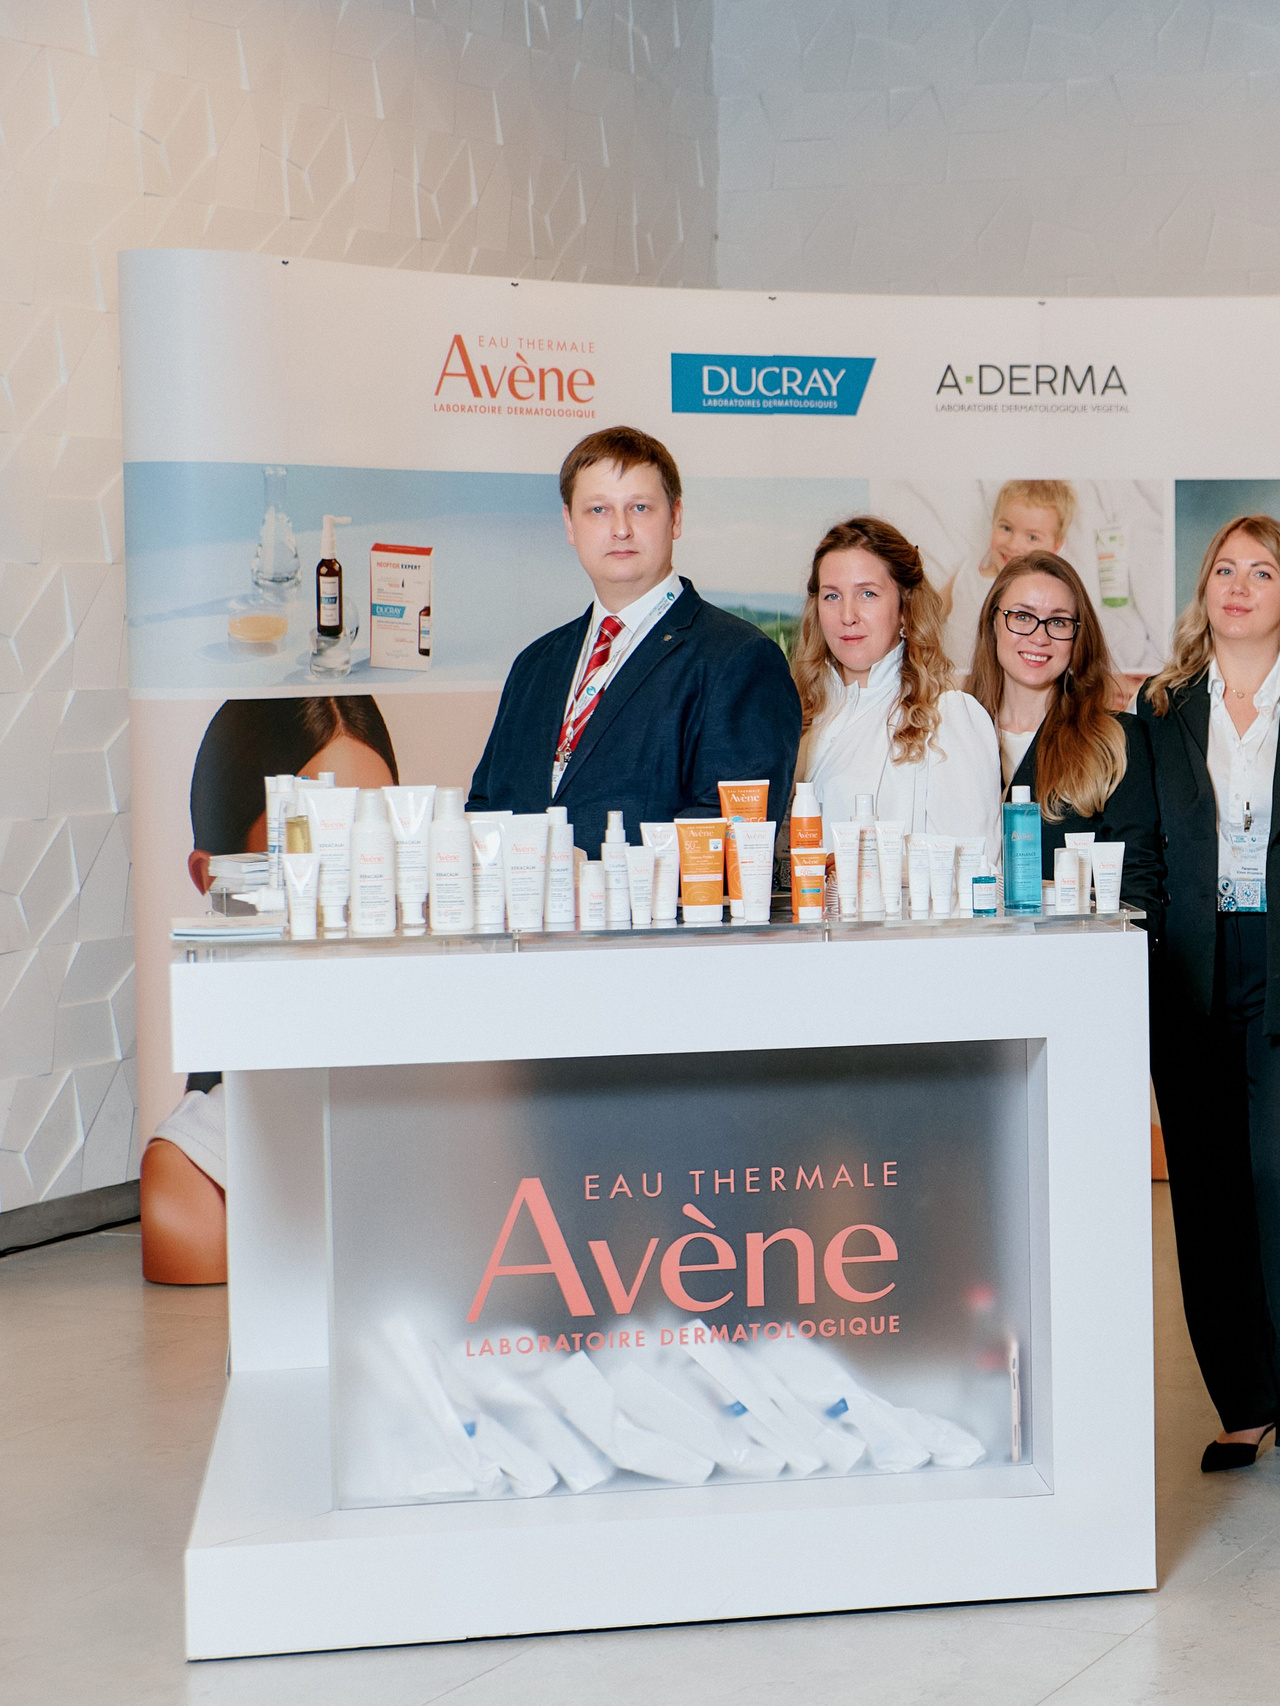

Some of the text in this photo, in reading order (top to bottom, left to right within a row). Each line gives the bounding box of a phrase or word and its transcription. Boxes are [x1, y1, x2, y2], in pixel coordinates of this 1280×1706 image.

[478, 335, 595, 354] EAU THERMALE
[434, 334, 595, 404] Avène
[702, 365, 846, 397] DUCRAY
[433, 403, 596, 419] LABORATOIRE DERMATOLOGIQUE
[702, 399, 838, 410] LABORATOIRES DERMATOLOGIQUES
[935, 404, 999, 413] LABORATOIRE
[375, 606, 402, 616] DUCRAY
[585, 1161, 898, 1201] EAU THERMALE
[466, 1177, 898, 1323] Avène
[466, 1315, 901, 1358] LABORATOIRE DERMATOLOGIQUE
